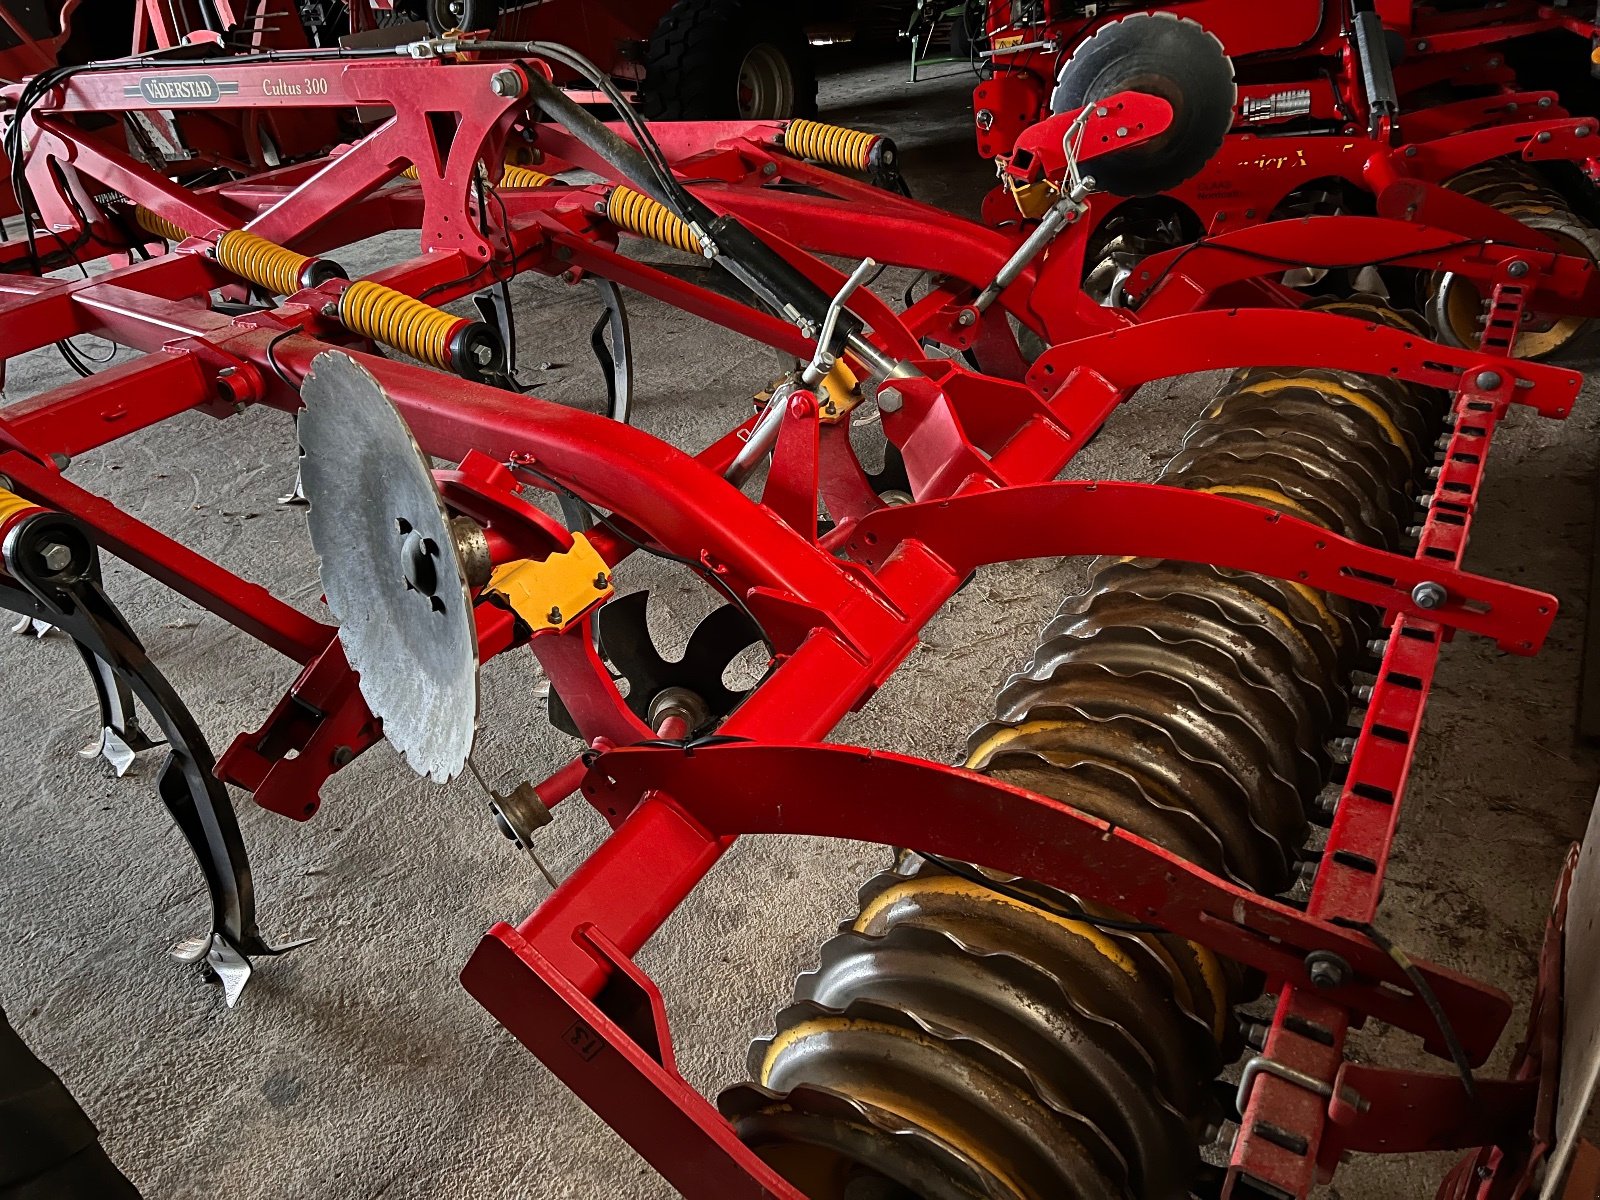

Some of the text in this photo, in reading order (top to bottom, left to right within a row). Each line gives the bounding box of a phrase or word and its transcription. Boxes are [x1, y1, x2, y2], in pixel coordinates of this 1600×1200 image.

[145, 80, 212, 99] VÄDERSTAD
[262, 77, 328, 96] Cultus 300
